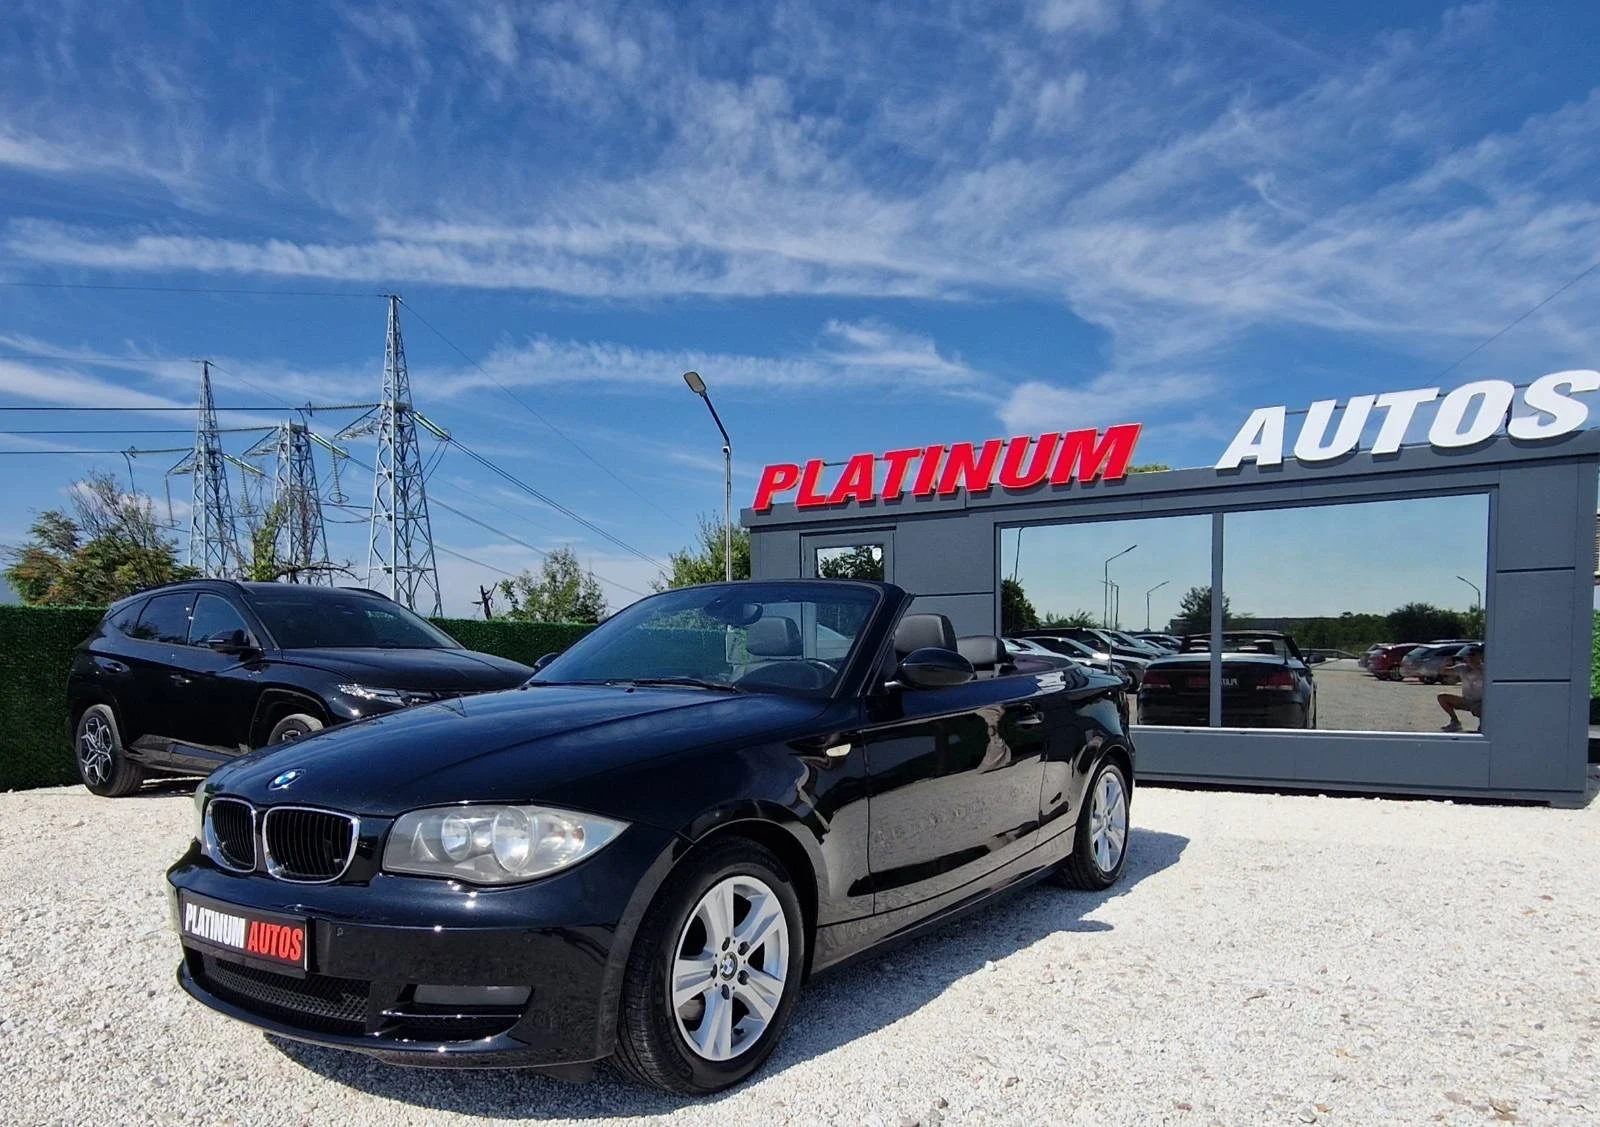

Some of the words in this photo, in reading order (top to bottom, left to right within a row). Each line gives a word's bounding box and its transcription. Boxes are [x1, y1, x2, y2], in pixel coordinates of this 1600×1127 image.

[753, 422, 1142, 511] PLATINUM
[1215, 369, 1600, 470] AUTOS
[185, 902, 246, 949] PLATINUM
[247, 920, 303, 961] AUTOS
